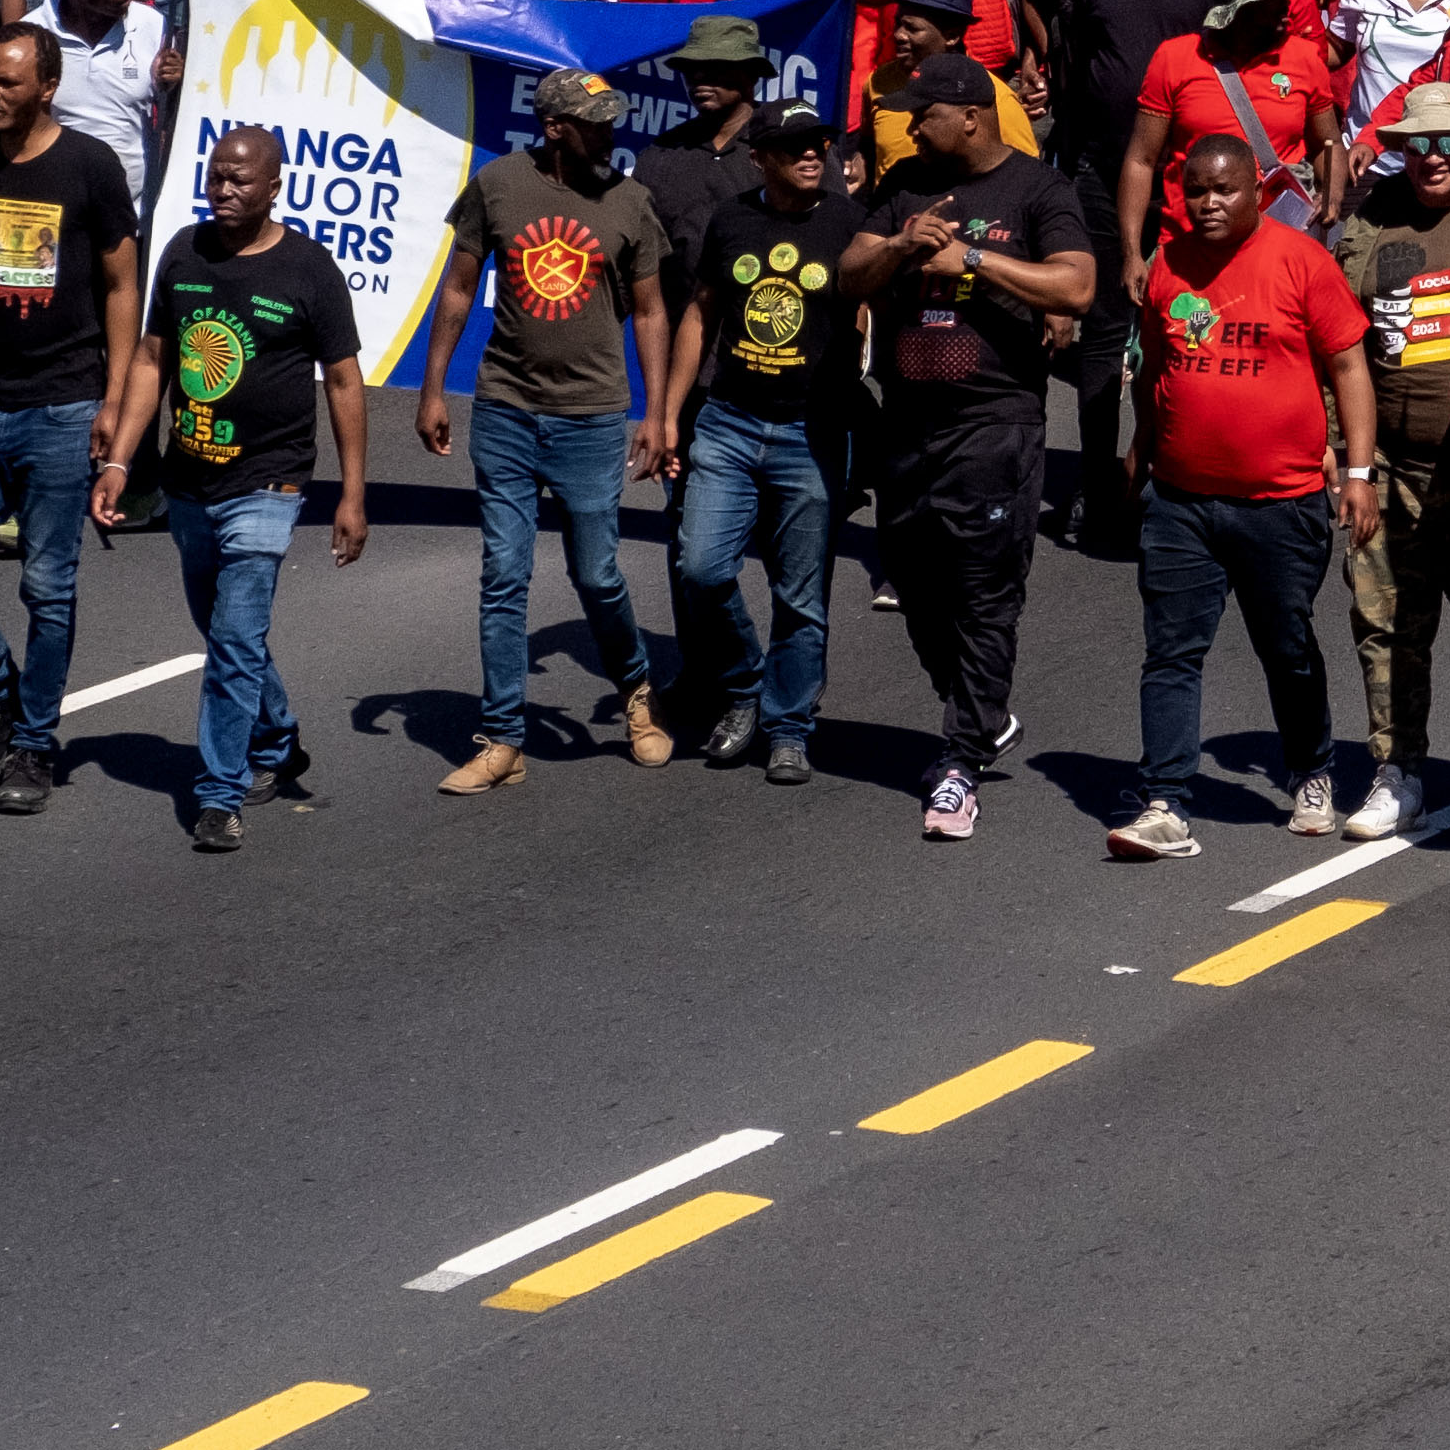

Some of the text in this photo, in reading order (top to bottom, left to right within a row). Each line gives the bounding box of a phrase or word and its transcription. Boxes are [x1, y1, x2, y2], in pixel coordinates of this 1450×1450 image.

[197, 117, 402, 178] NANGA
[192, 161, 400, 222] LUOR
[988, 230, 1011, 242] EFF
[540, 282, 567, 292] LAND
[1381, 302, 1401, 312] EAT
[747, 309, 771, 324] PAC
[921, 310, 956, 324] 2023
[192, 307, 256, 362] OF AZANIA
[1220, 321, 1270, 346] EFF
[1411, 322, 1442, 336] 2021
[1219, 358, 1267, 378] EFF
